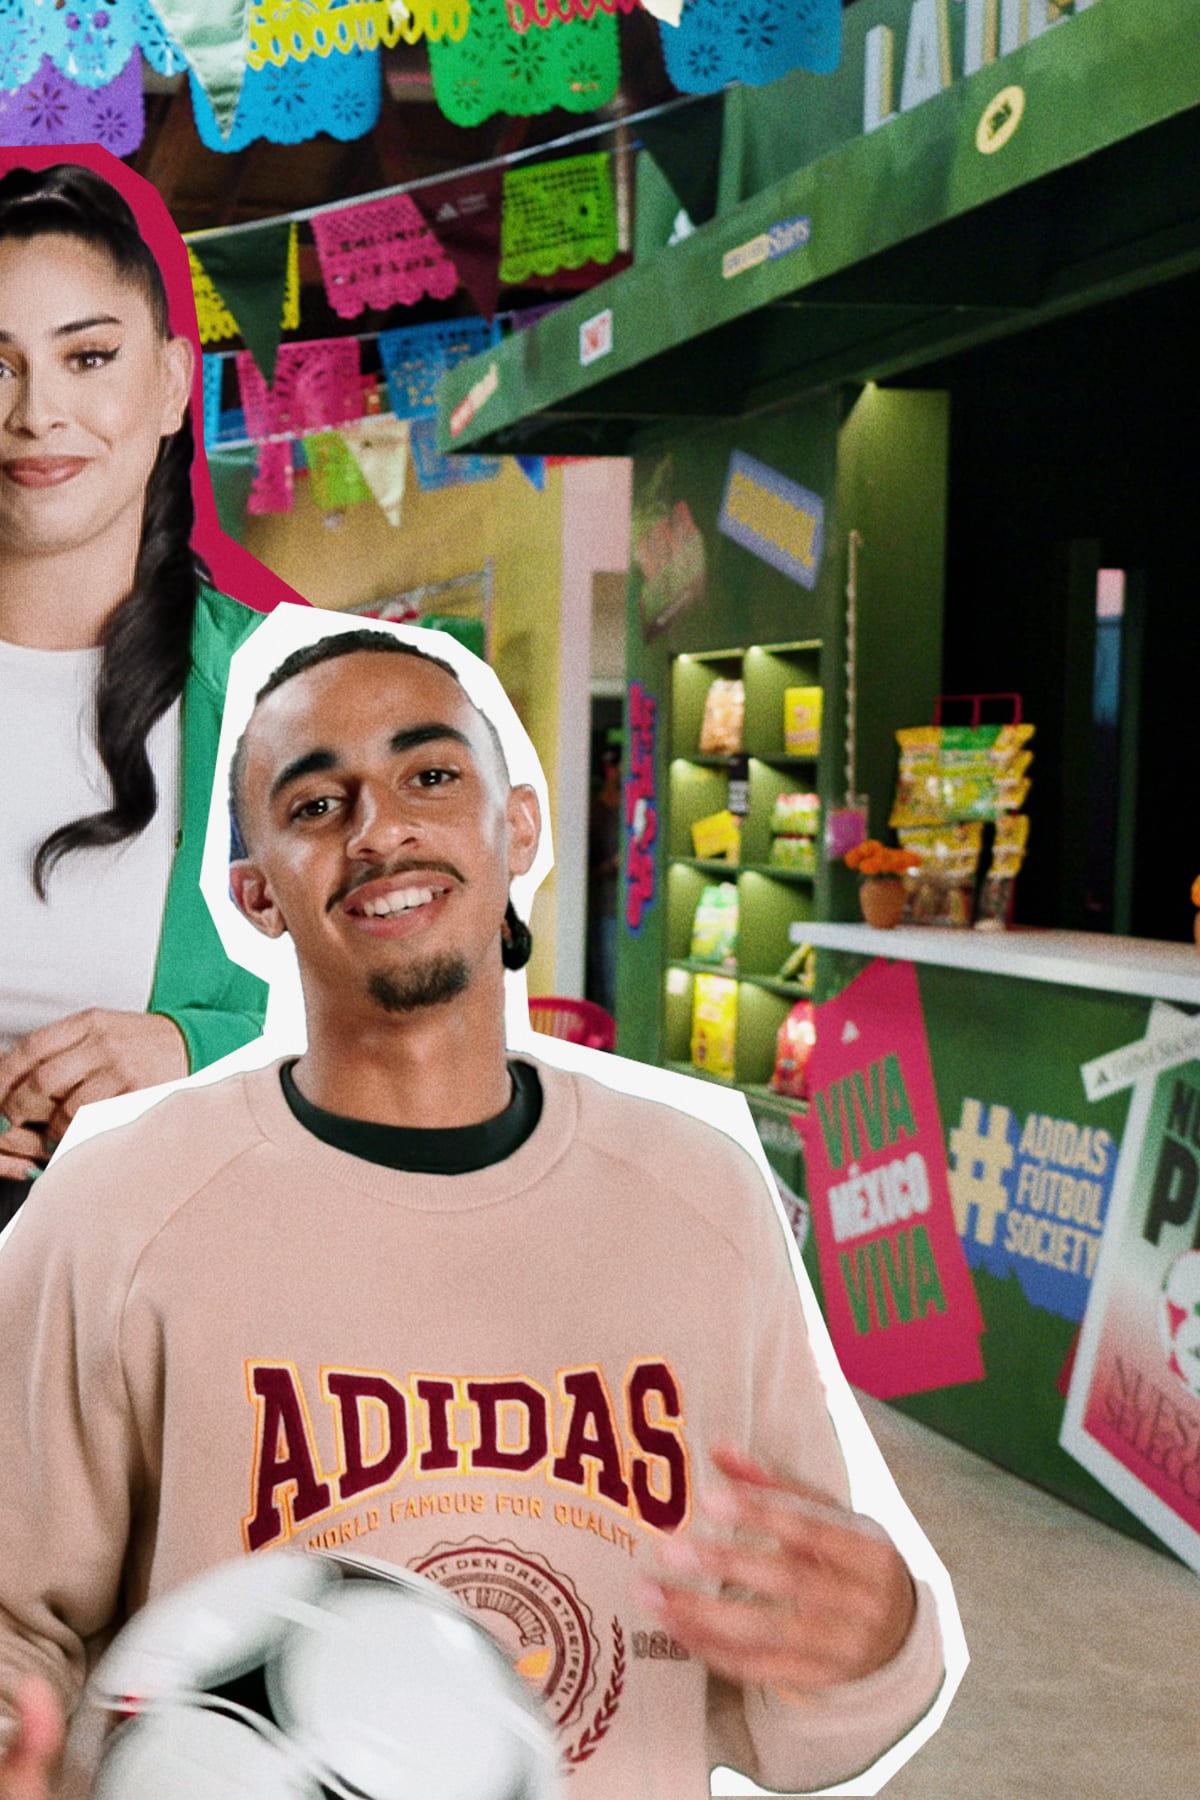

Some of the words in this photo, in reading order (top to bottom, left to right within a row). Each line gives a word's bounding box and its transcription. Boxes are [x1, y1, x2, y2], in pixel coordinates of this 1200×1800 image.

[813, 1052, 918, 1169] VIVA
[1019, 1111, 1111, 1176] ADIDAS
[828, 1151, 931, 1243] MÉXICO
[1017, 1159, 1102, 1229] FÚTBOL
[838, 1223, 946, 1335] VIVA
[1004, 1210, 1100, 1280] SOCIETY
[241, 1356, 693, 1552] ADIDAS
[302, 1508, 380, 1552] WORLD
[390, 1493, 486, 1524] FAMOUS
[495, 1493, 543, 1519] FOR
[554, 1503, 638, 1556] QUALITY
[456, 1557, 499, 1570] DEN
[503, 1560, 549, 1595] DREI
[551, 1595, 580, 1696] STREIFEN
